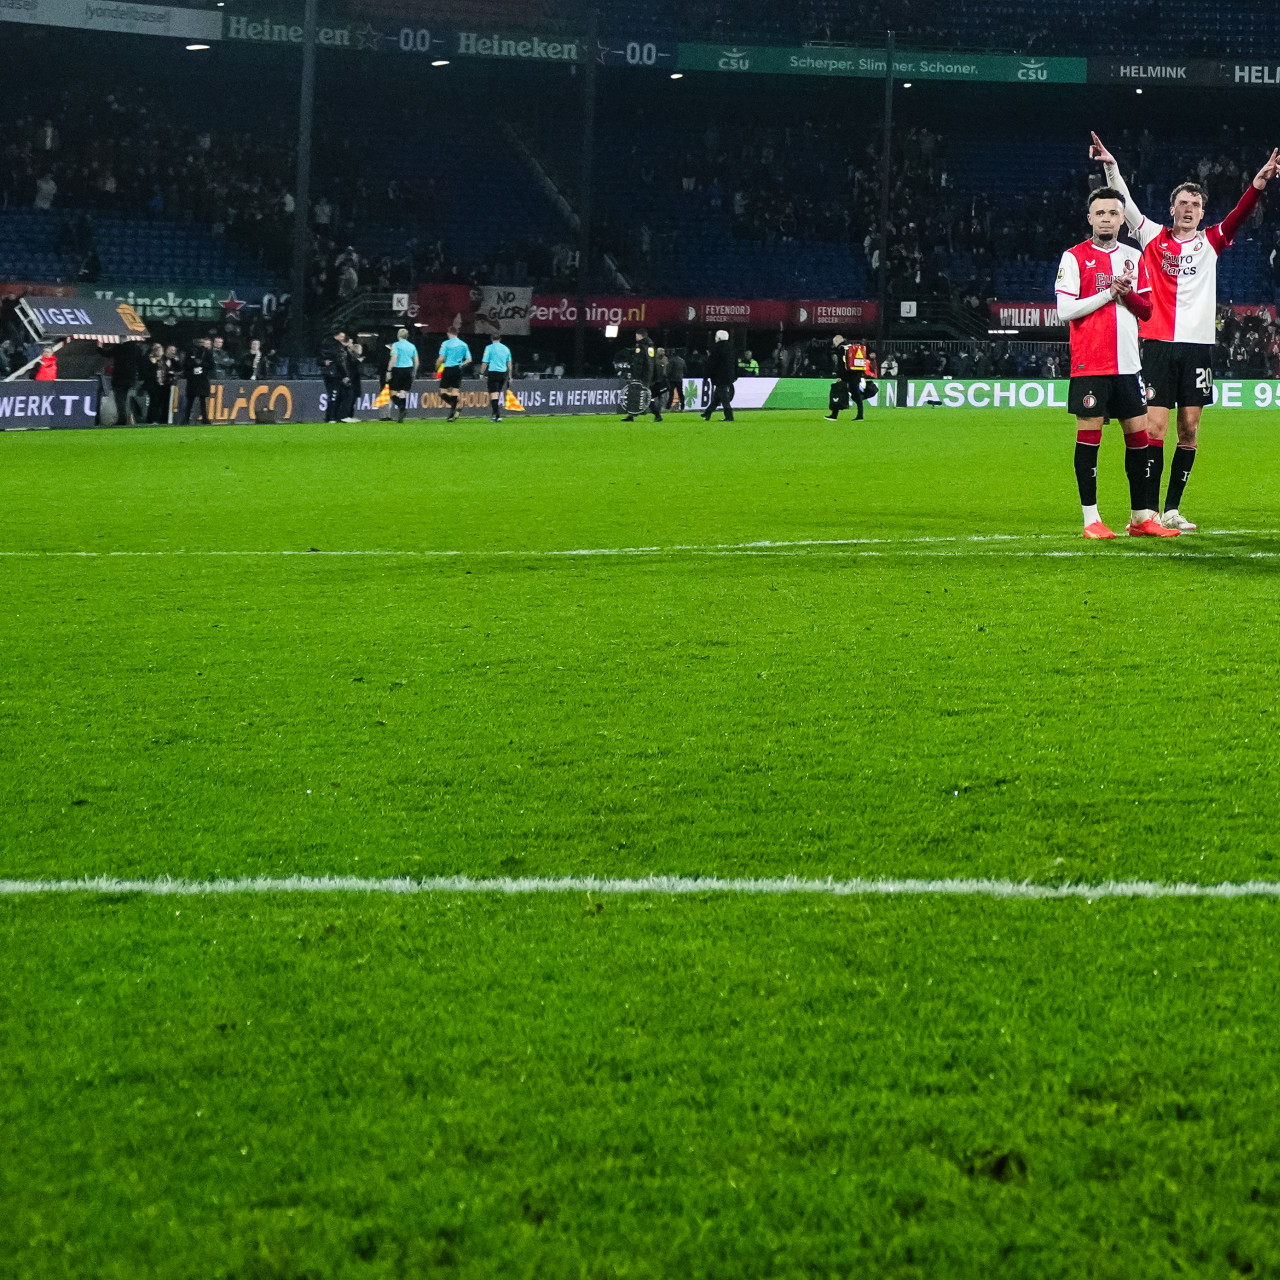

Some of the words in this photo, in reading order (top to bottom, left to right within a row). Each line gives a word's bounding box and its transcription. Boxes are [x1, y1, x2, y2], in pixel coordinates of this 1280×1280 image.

[229, 15, 349, 47] Heineen
[457, 32, 577, 60] Heineken
[718, 58, 749, 71] CSU
[789, 55, 854, 71] Scherper.
[919, 61, 978, 75] Schoner.
[1120, 65, 1187, 79] HELMINK
[1017, 68, 1048, 81] CSU
[1162, 251, 1193, 265] Euro
[1162, 263, 1197, 276] Parcs
[497, 291, 515, 303] NO
[1000, 308, 1040, 327] WILLEM
[1195, 368, 1212, 389] 20
[549, 390, 563, 406] EN
